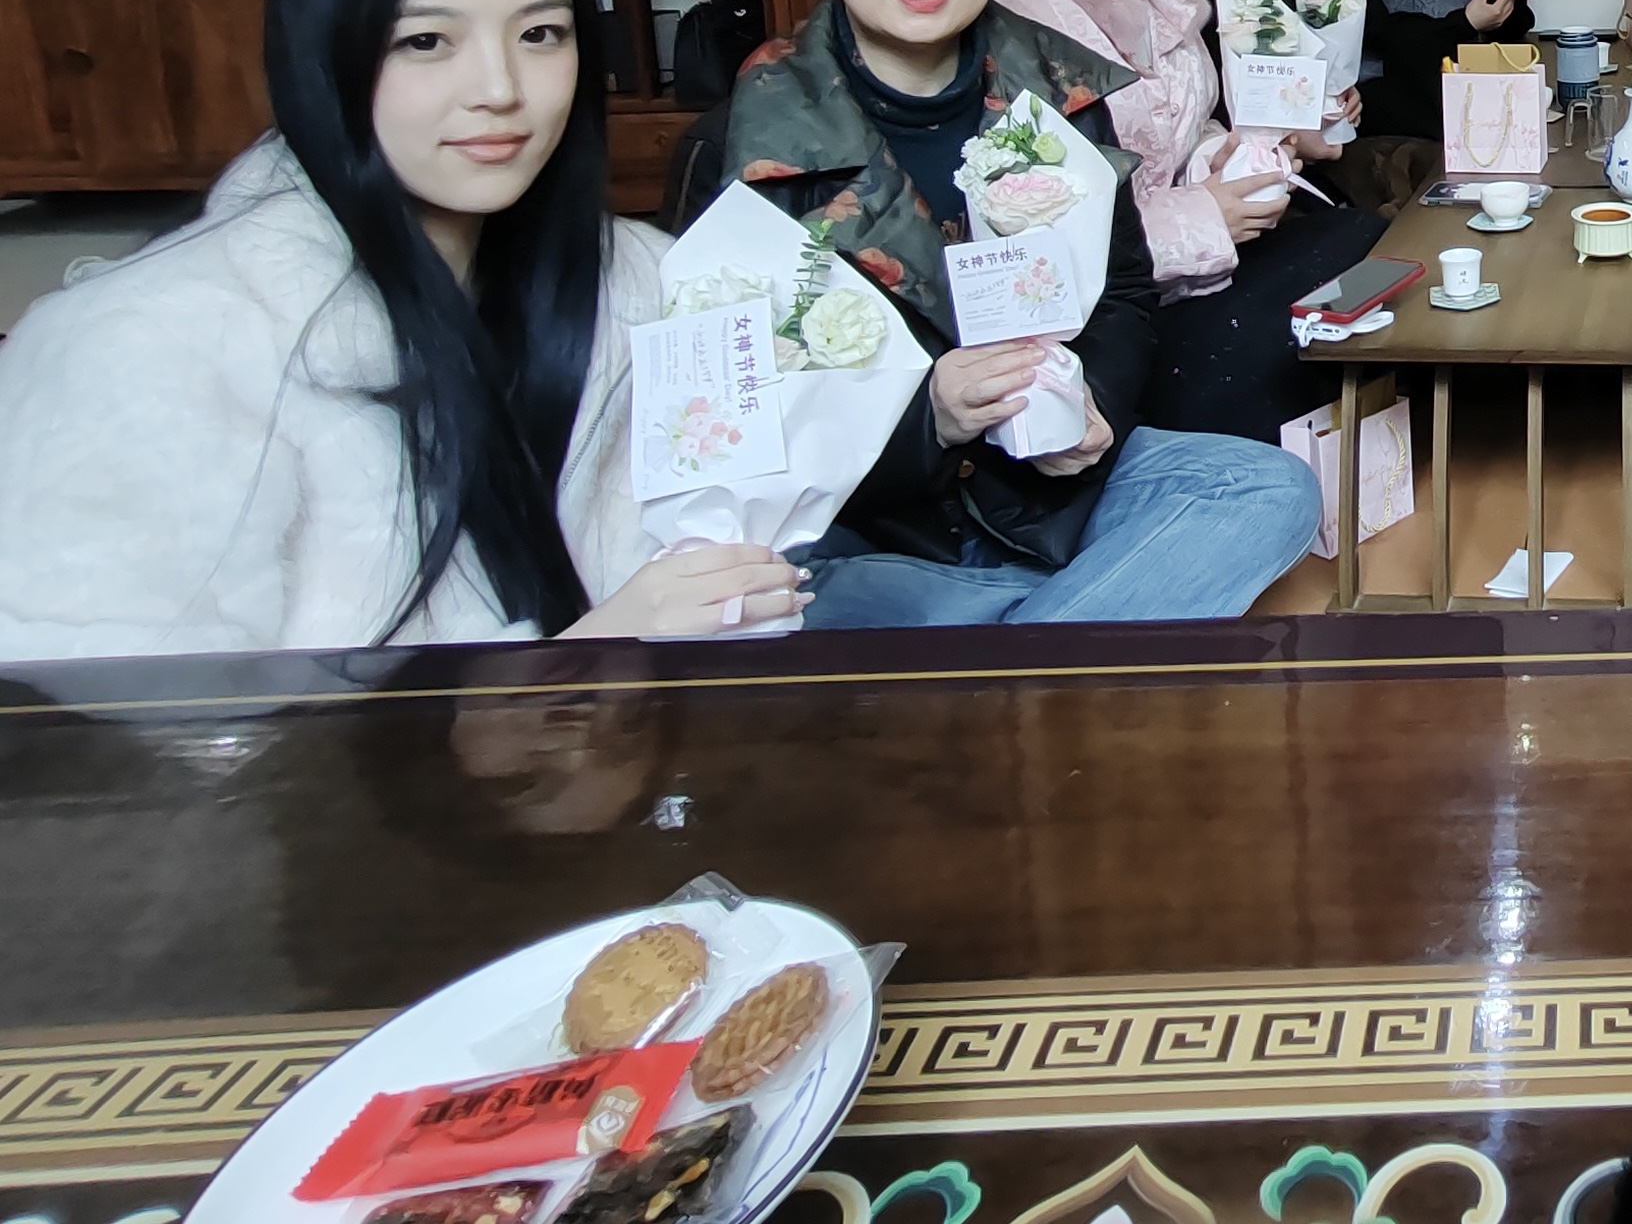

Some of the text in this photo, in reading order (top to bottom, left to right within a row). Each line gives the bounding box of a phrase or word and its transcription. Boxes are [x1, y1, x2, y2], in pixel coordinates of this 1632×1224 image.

[956, 247, 1028, 271] 女神节快乐
[732, 313, 761, 415] 女神节快乐
